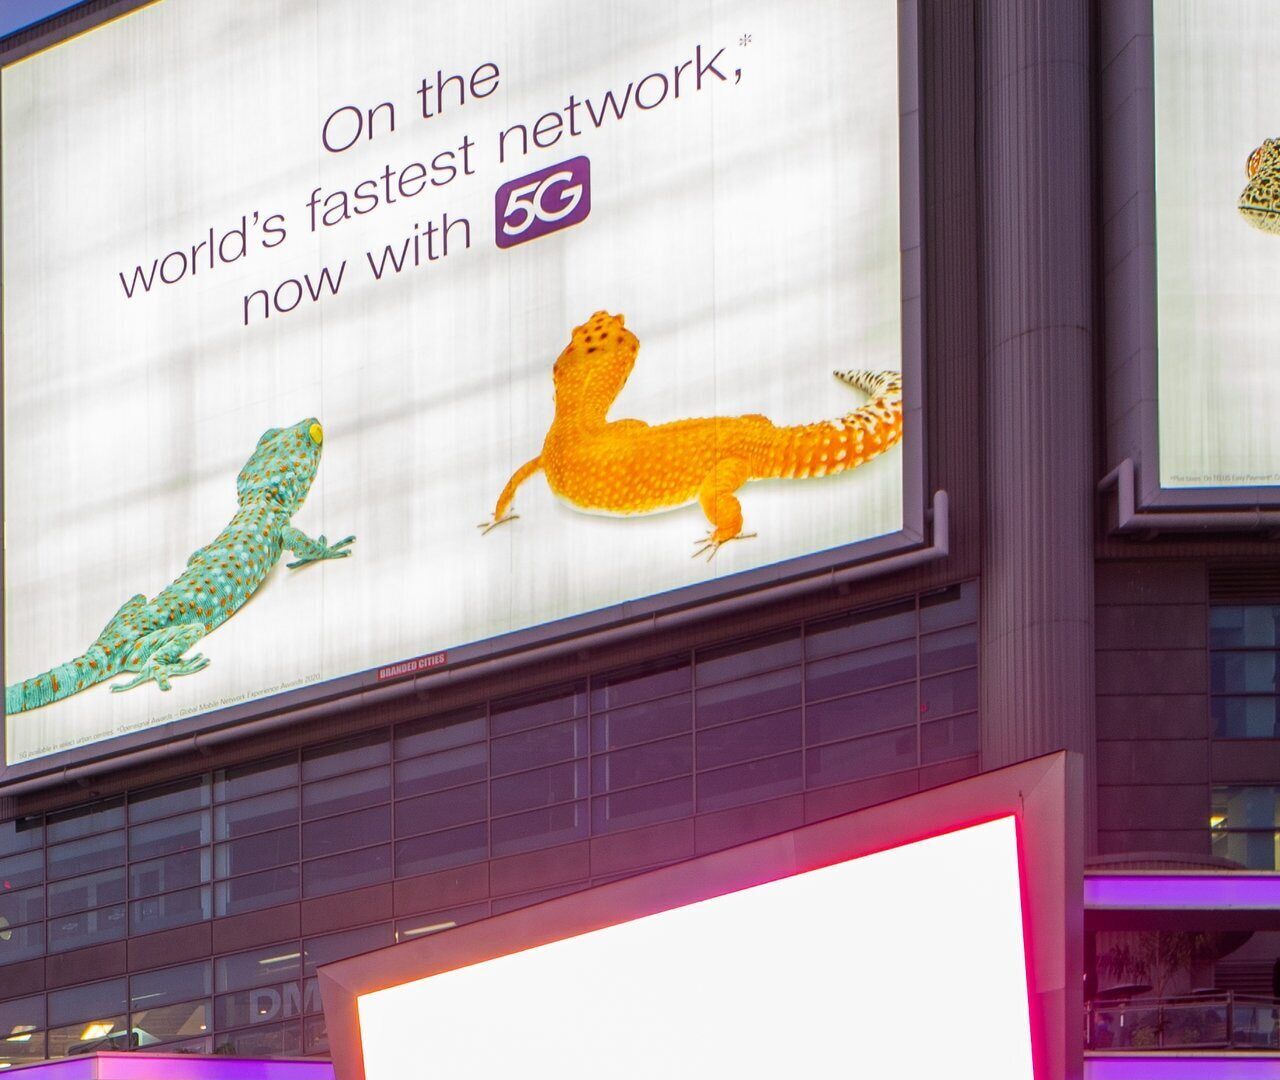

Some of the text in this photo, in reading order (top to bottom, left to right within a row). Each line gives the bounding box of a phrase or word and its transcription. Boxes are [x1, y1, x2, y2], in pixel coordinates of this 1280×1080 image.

[320, 61, 502, 154] On the
[117, 209, 288, 300] world's
[305, 136, 476, 233] fastest
[243, 168, 584, 326] now with 5G
[379, 653, 446, 681] BRANDED CITIES
